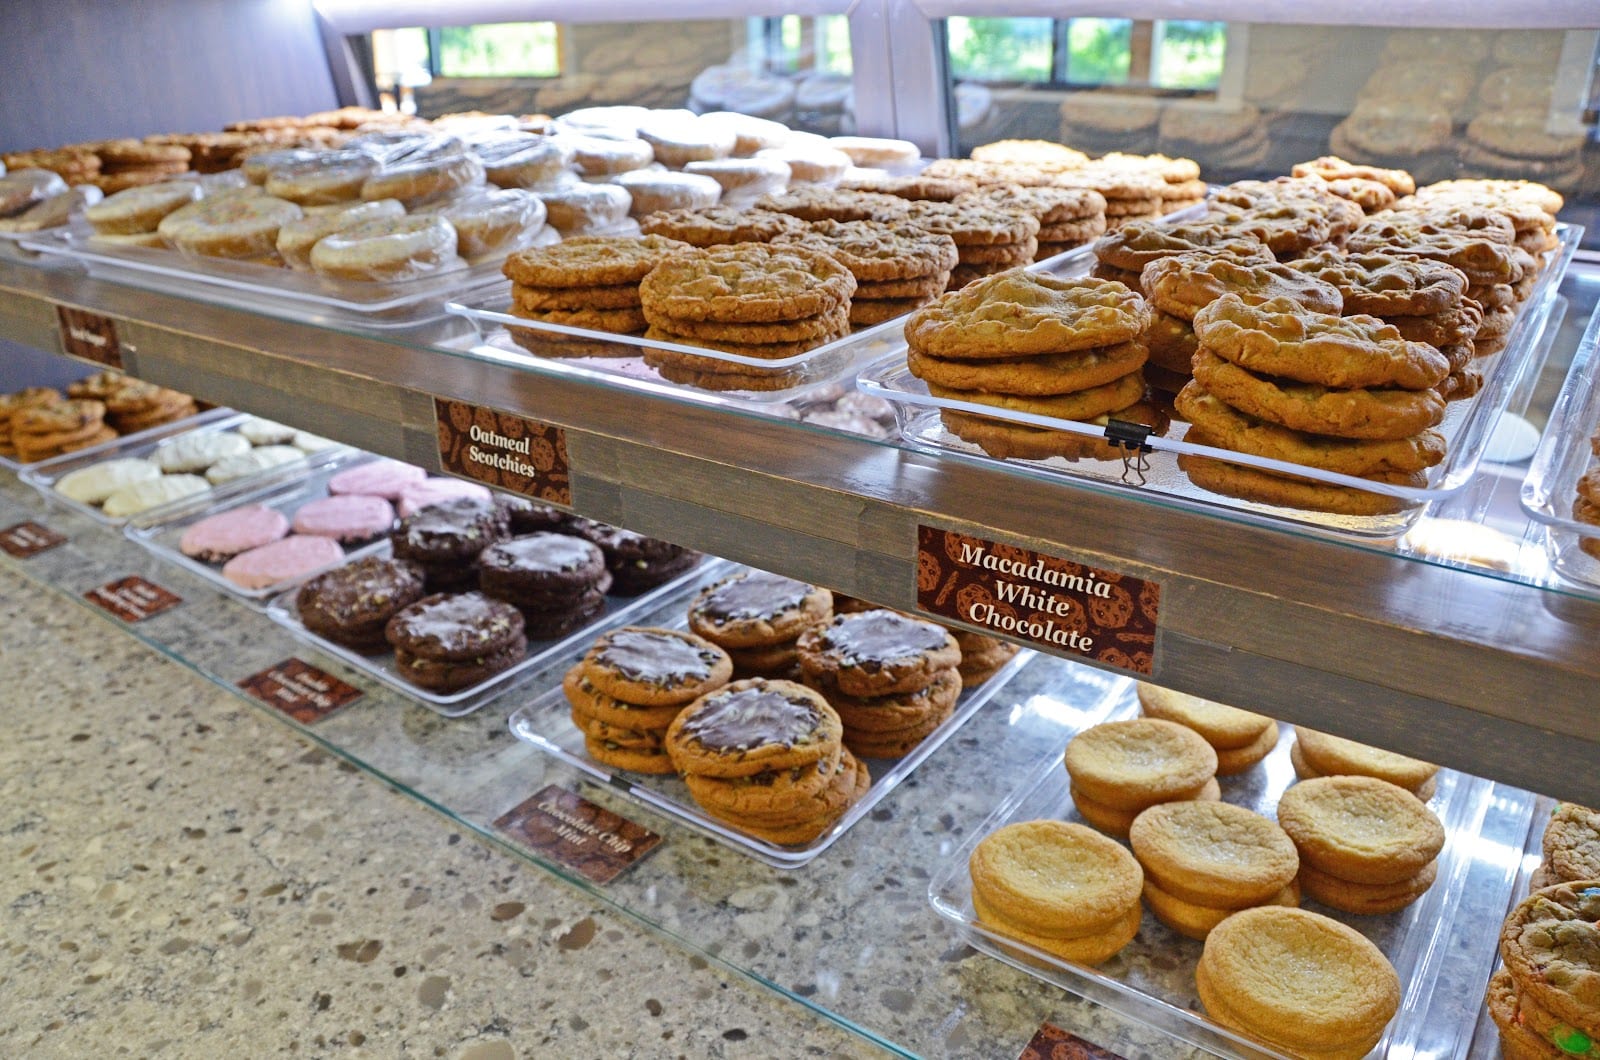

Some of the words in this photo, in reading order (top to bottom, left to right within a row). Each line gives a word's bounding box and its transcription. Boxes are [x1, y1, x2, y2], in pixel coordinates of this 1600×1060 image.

[470, 425, 530, 455] Oatmeal
[469, 445, 535, 478] Scotchies
[959, 543, 1111, 599] Macadamia
[995, 580, 1070, 617] White
[969, 602, 1094, 652] Chocolate
[553, 825, 588, 846] Mint
[598, 831, 632, 853] Chip
